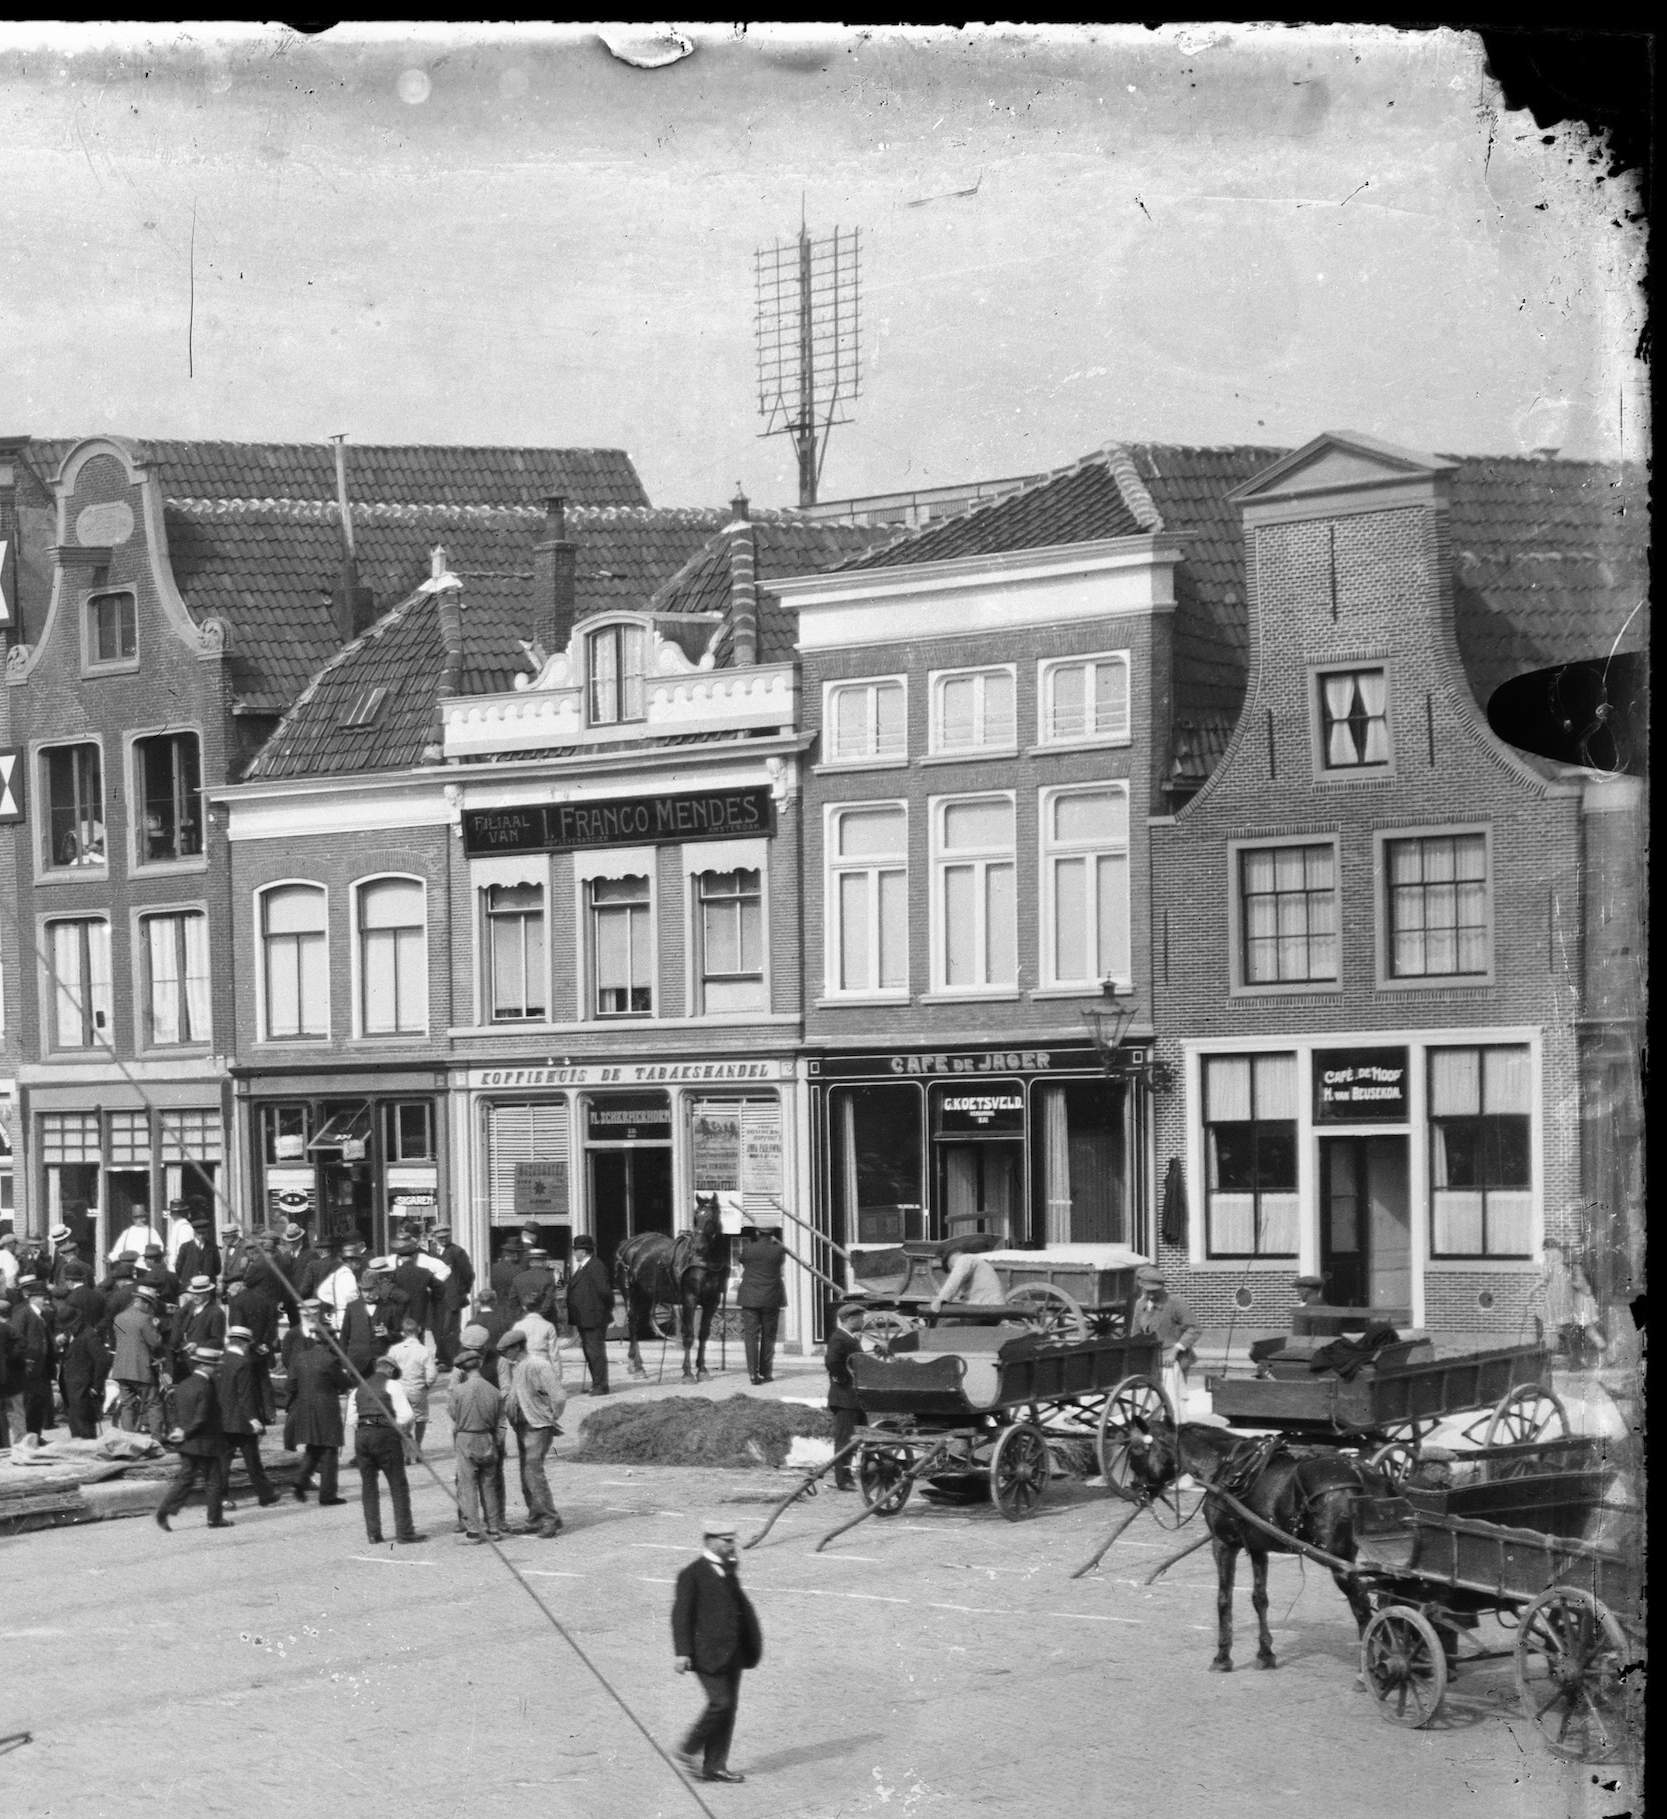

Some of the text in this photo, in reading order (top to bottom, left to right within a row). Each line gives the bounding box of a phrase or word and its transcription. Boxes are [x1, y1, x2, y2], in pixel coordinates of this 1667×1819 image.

[474, 813, 532, 831] FILIAAL
[559, 804, 649, 838] FRANCO
[654, 795, 760, 832] MENDES
[488, 827, 518, 844] VAN
[953, 1058, 974, 1072] DE
[978, 1052, 1050, 1071] JAGER
[480, 1063, 769, 1085] KOFFIEHUIS DE TABAKSHANDEL
[396, 1195, 434, 1206] SIGAREN
